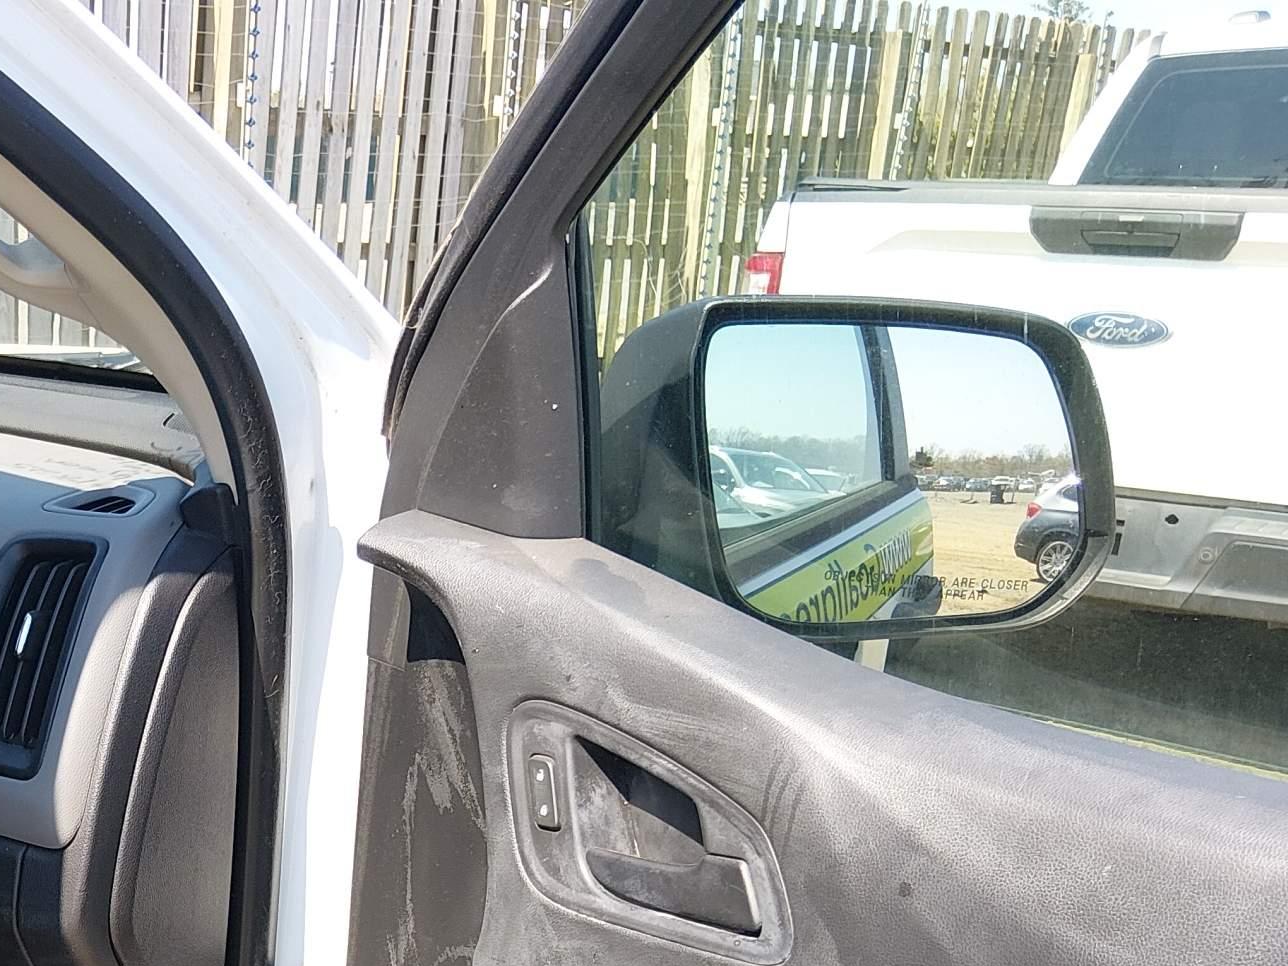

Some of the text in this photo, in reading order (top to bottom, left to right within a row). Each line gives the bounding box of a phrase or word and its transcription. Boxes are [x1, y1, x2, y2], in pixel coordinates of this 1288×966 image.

[1086, 314, 1148, 342] Ford
[951, 577, 977, 589] ARE
[981, 578, 1029, 591] CLOSER
